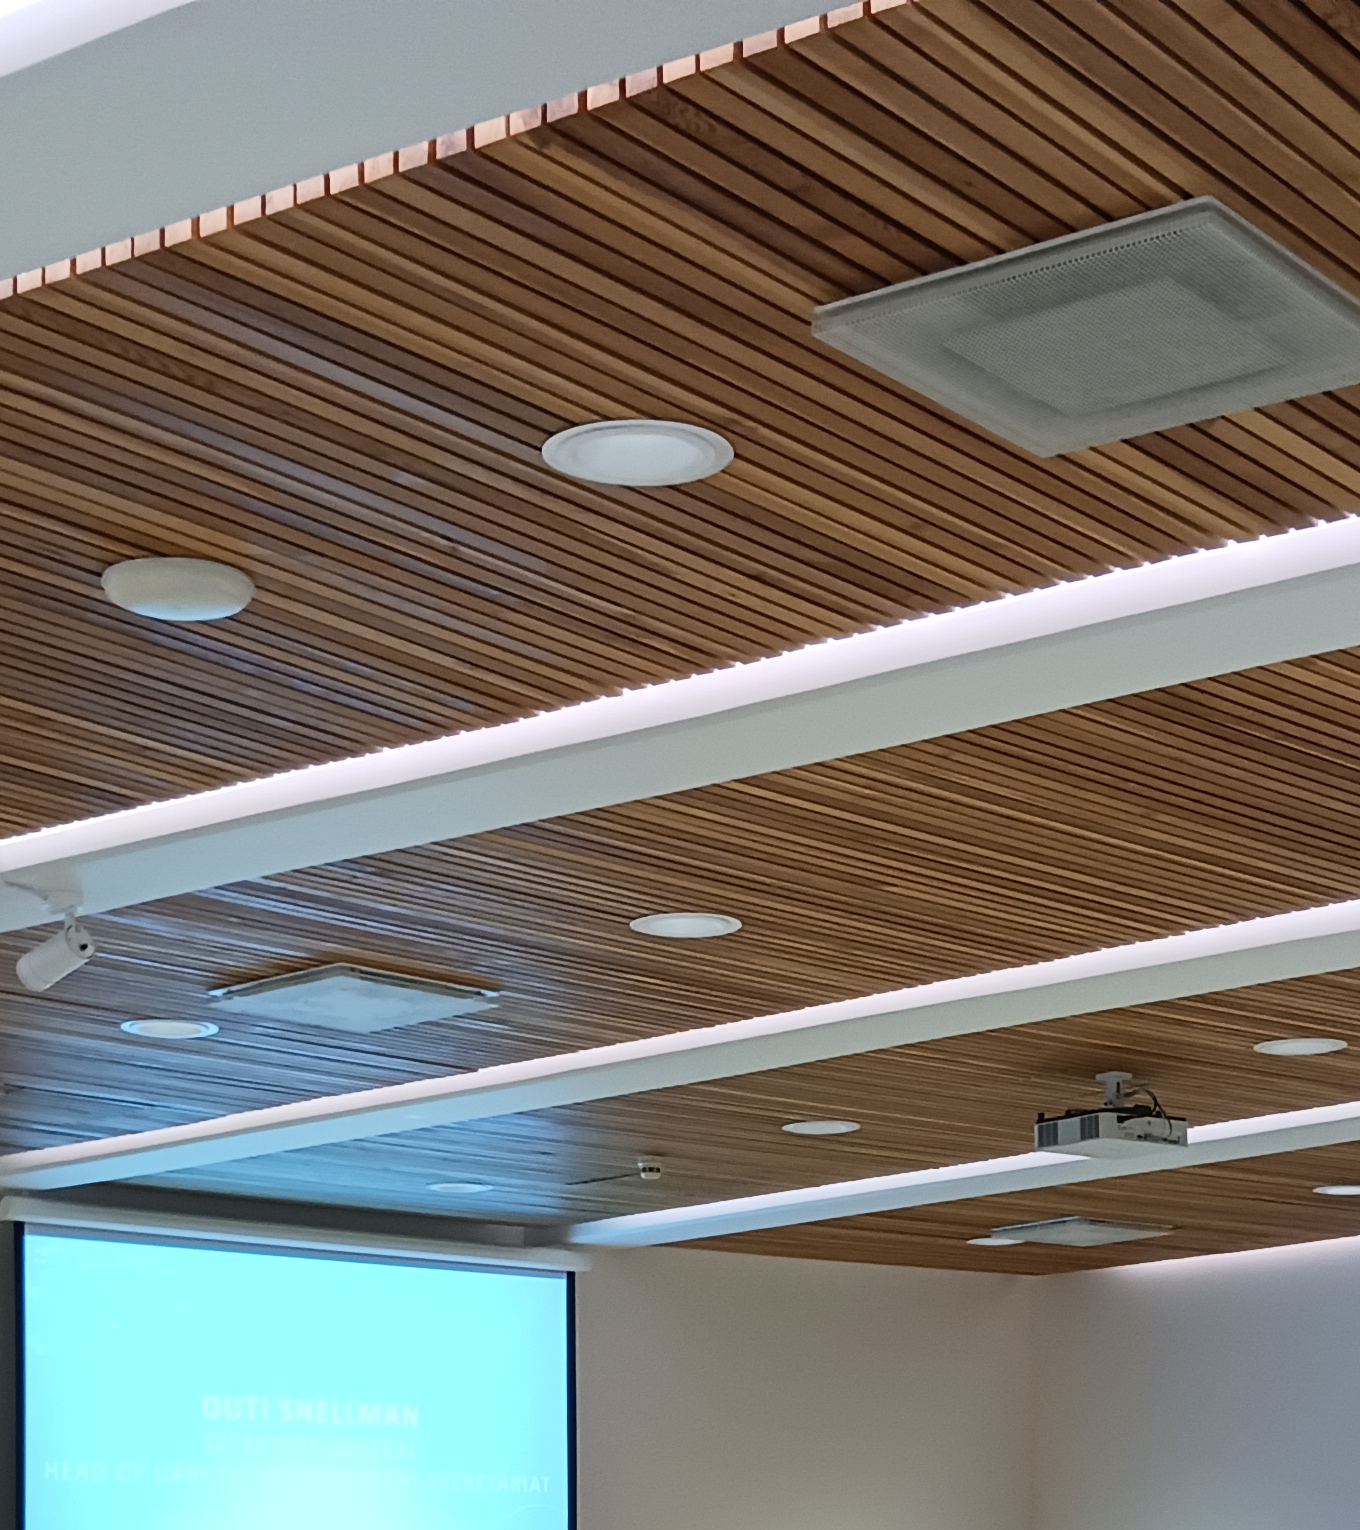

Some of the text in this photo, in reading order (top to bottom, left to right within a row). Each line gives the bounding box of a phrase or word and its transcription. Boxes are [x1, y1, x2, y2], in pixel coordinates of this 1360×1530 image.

[200, 1394, 420, 1429] OUTI SNELLMAN
[44, 1460, 107, 1482] HEAD
[116, 1461, 144, 1483] OF
[428, 1473, 551, 1493] SECRETARIAT
